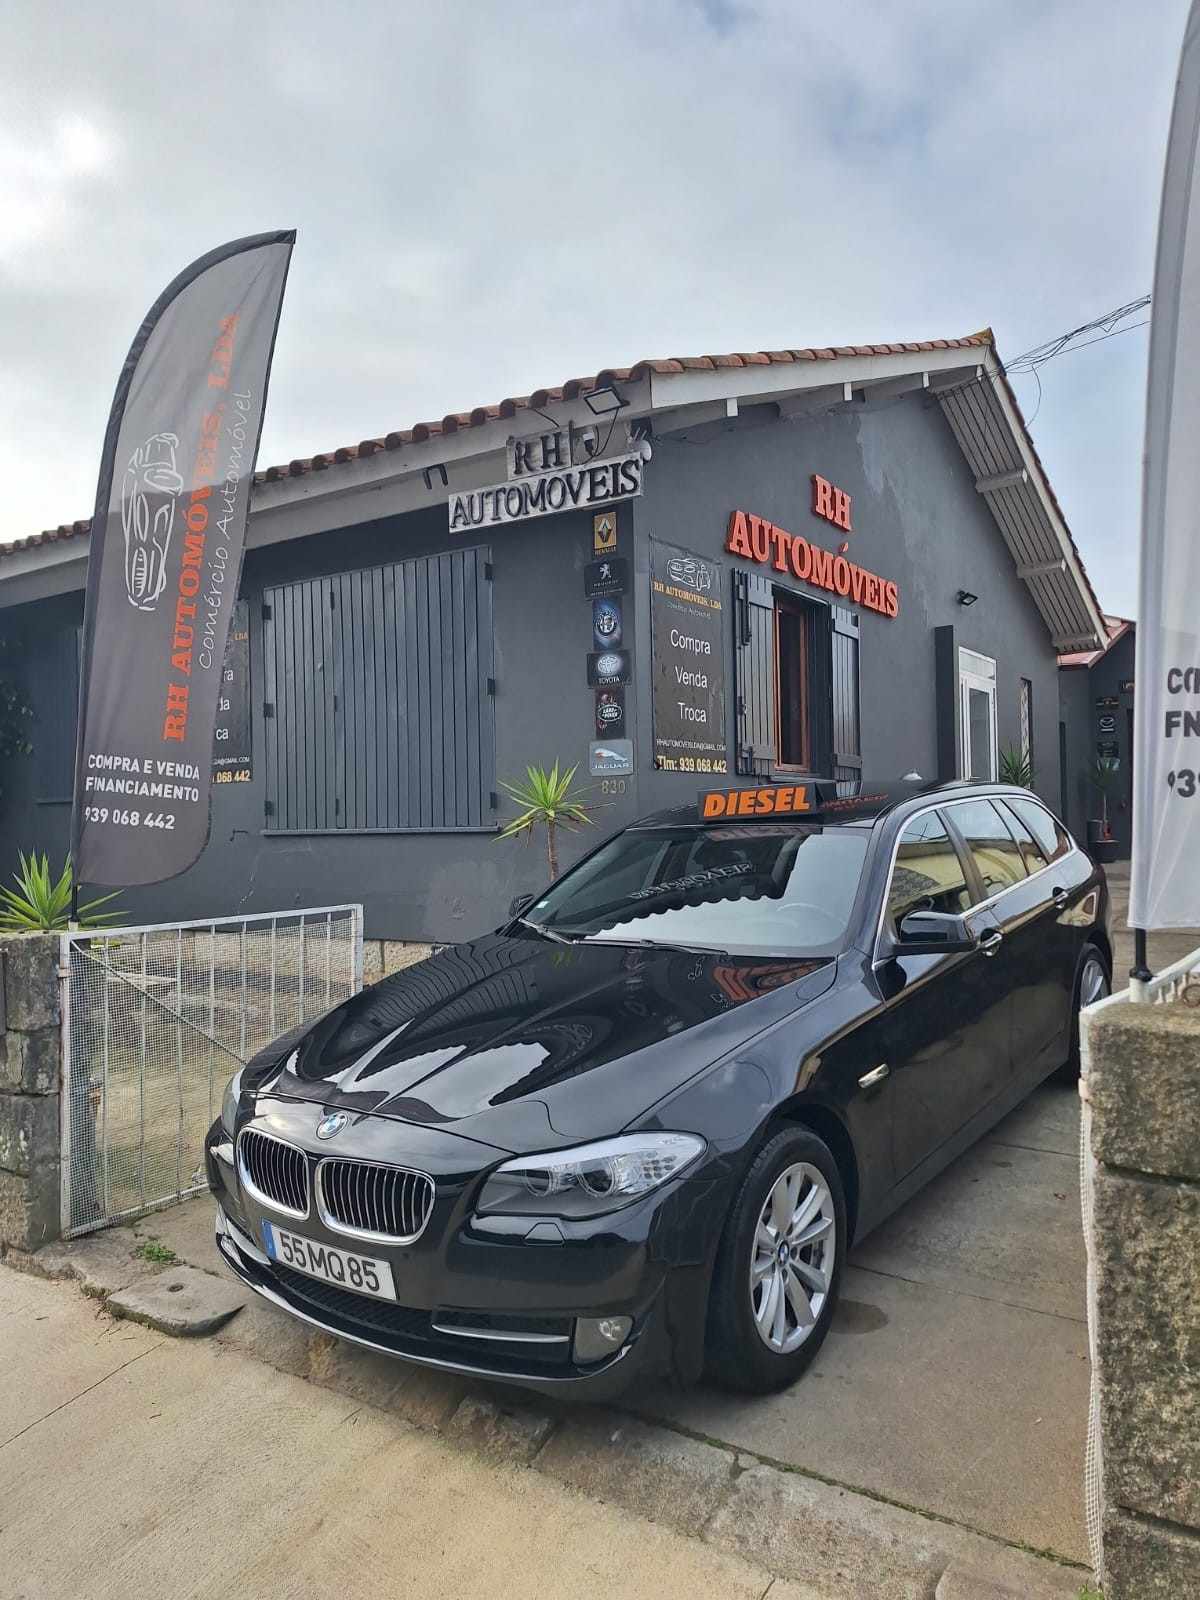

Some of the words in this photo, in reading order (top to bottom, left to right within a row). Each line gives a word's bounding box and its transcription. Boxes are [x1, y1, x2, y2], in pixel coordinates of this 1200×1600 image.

[450, 459, 640, 529] AUTOMOVEIS
[812, 474, 852, 532] RH
[726, 510, 899, 618] AUTOMÓVEIS
[670, 629, 711, 655] Compra
[674, 665, 708, 688] Venda
[163, 684, 189, 742] RH
[677, 702, 707, 723] Troca
[88, 754, 140, 773] COMPRA
[143, 760, 153, 774] E
[156, 761, 200, 781] VENDA
[679, 757, 695, 772] 939
[696, 758, 711, 773] 068
[712, 759, 728, 773] 442
[85, 776, 199, 802] FINANCIAMENTO
[703, 786, 810, 818] DIESEL
[112, 809, 140, 826] 068
[143, 812, 176, 830] 442
